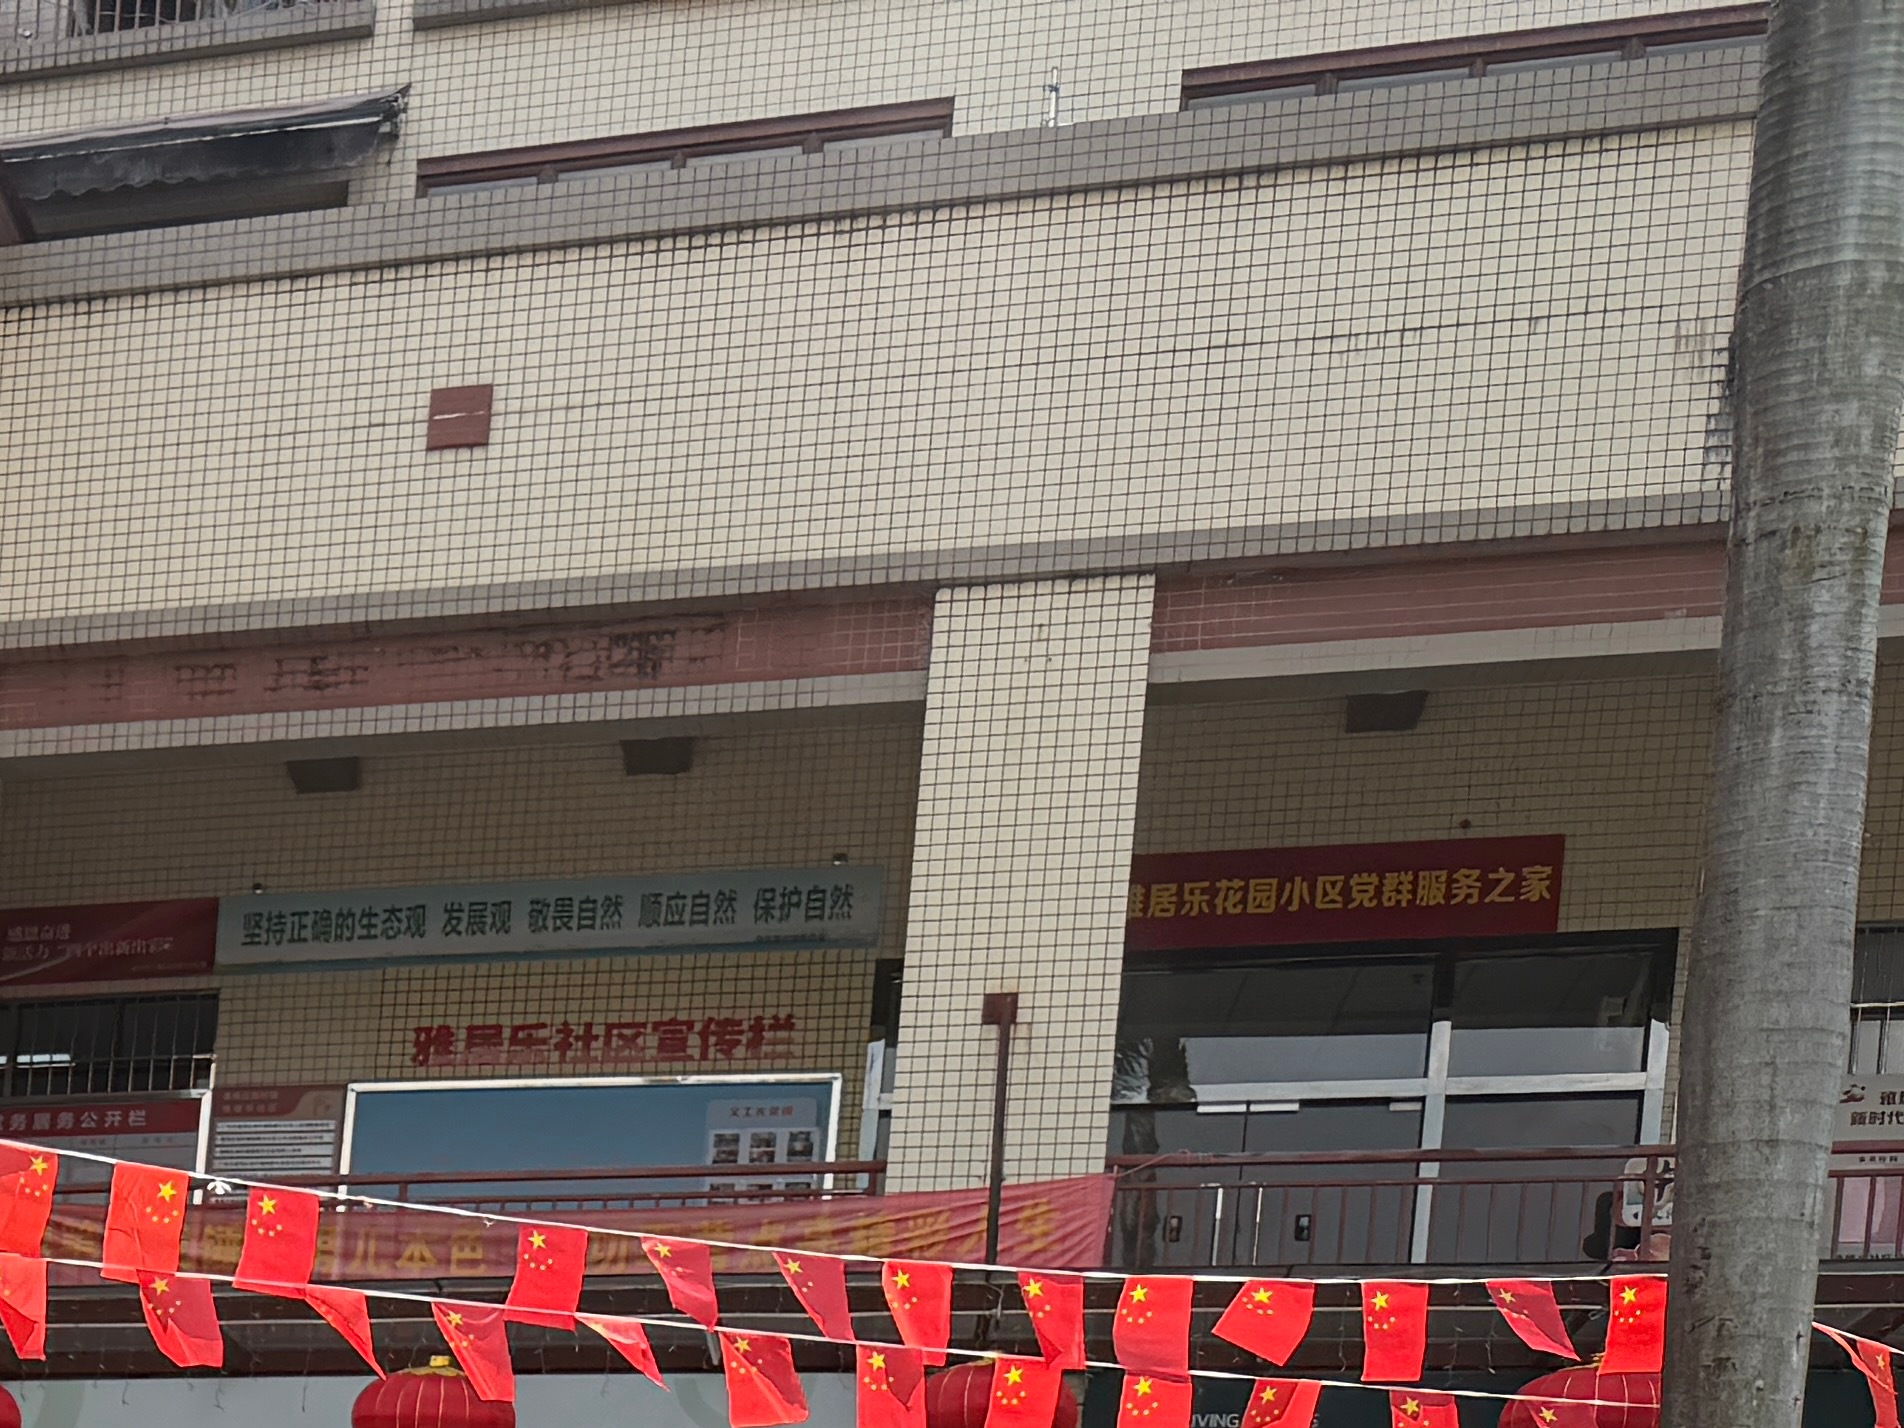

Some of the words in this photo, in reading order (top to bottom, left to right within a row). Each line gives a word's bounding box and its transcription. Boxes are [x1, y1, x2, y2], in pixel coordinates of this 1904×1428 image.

[241, 903, 427, 948] 坚持正确的生态观
[442, 900, 512, 938] 发展观
[527, 895, 624, 933] 敬畏自然
[637, 889, 738, 929] 顺应自然
[753, 883, 854, 924] 保护自然
[410, 1013, 798, 1067] 雅居乐社区宣传栏
